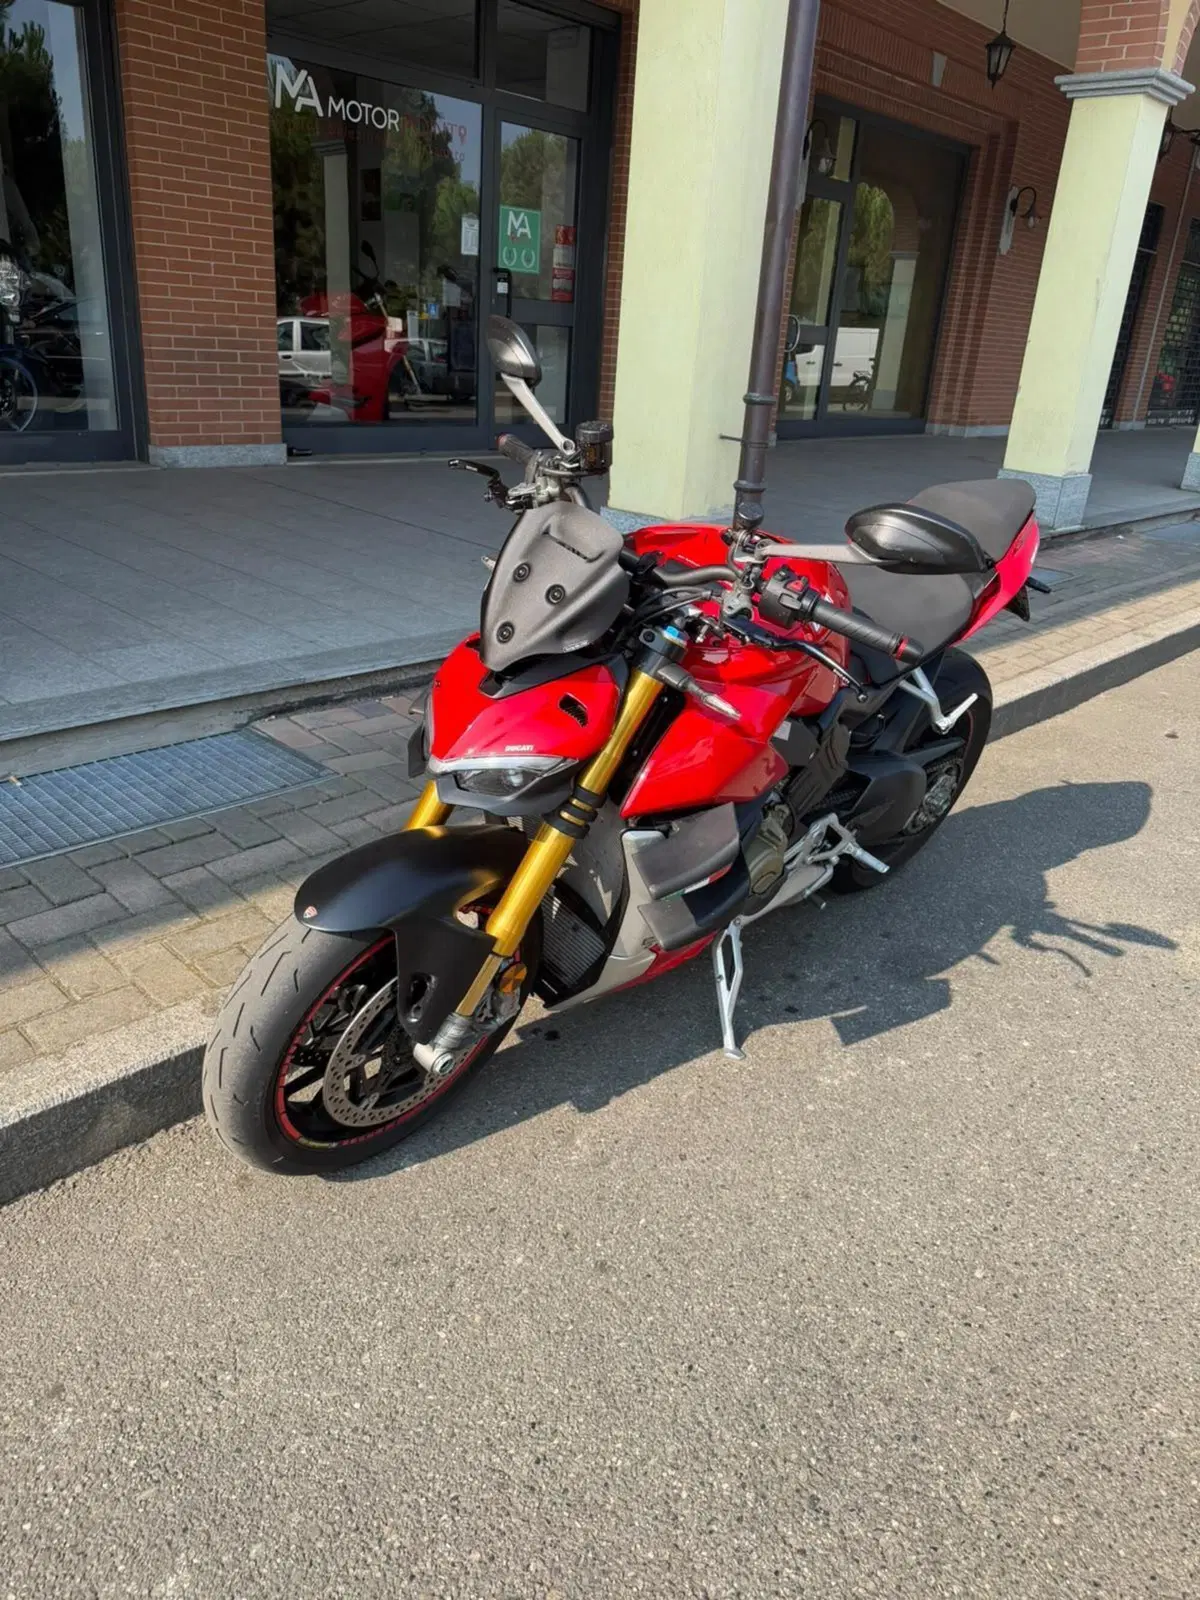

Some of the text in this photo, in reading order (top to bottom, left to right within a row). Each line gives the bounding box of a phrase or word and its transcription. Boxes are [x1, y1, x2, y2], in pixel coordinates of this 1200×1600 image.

[274, 63, 324, 118] MA
[327, 95, 400, 132] MOTOR
[507, 210, 532, 239] MA
[503, 744, 535, 752] DUCATI
